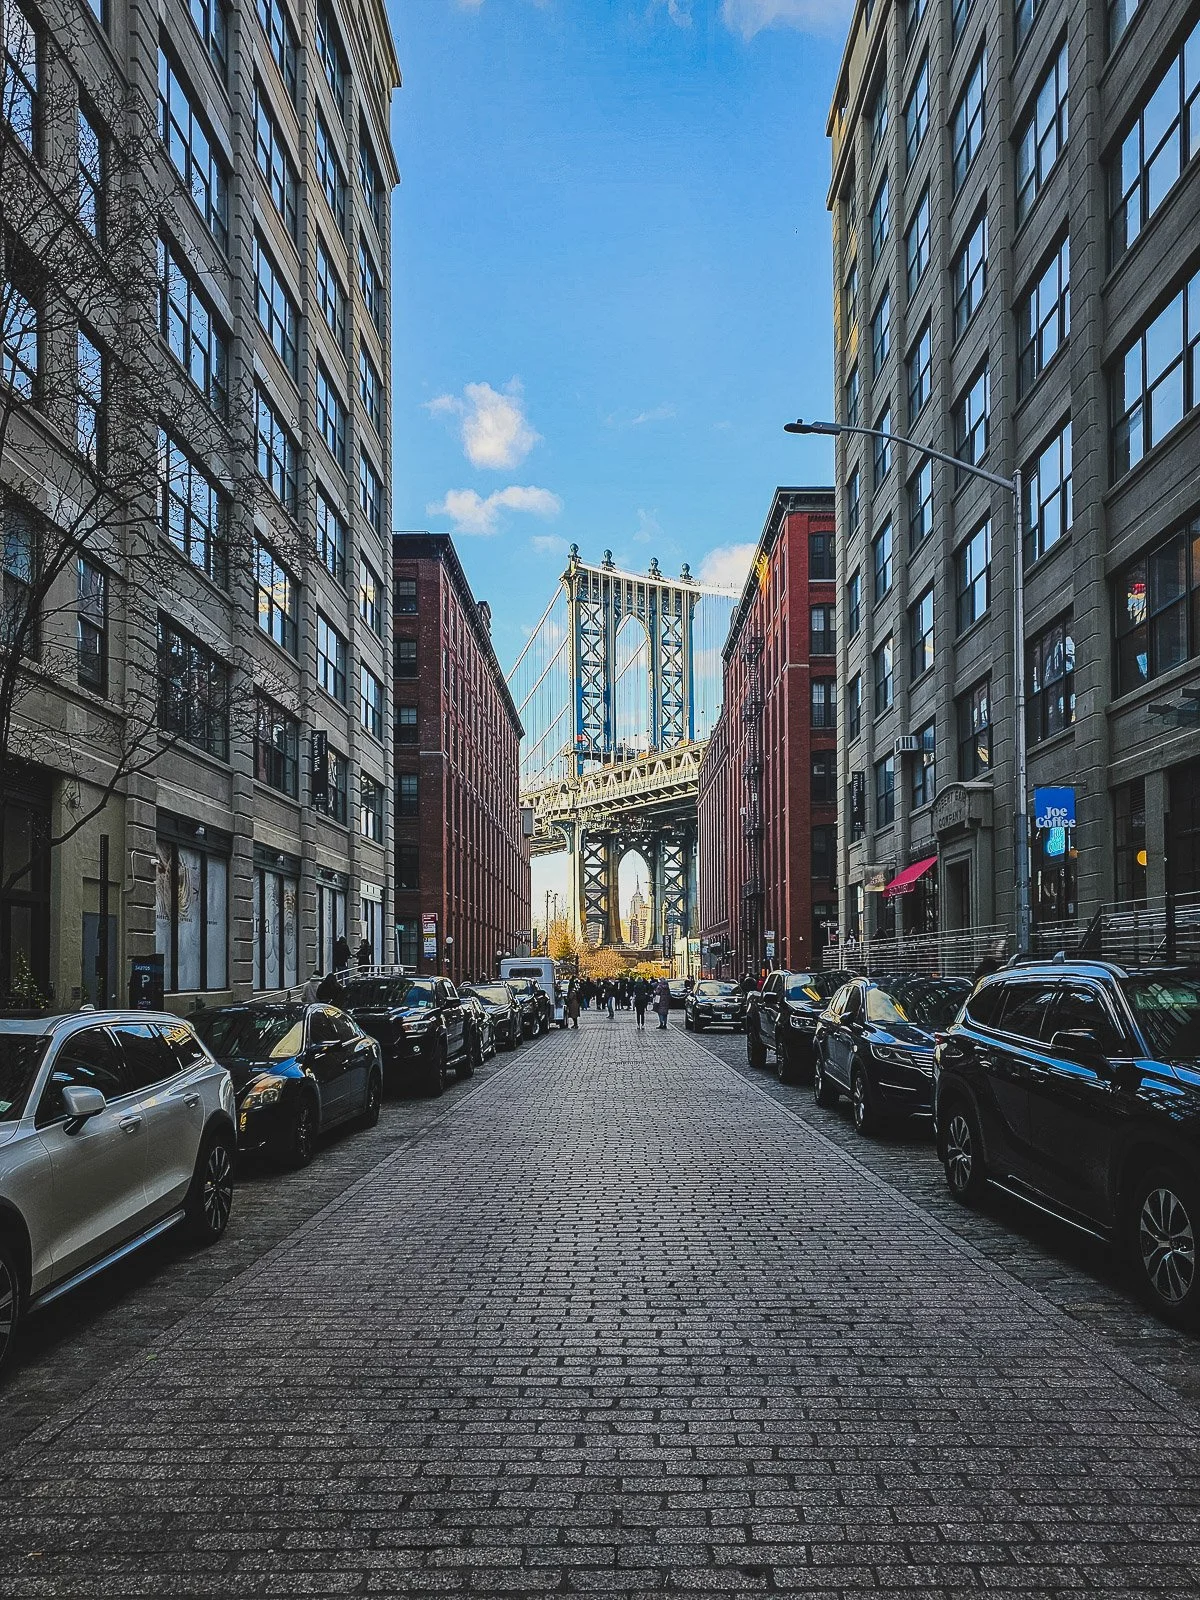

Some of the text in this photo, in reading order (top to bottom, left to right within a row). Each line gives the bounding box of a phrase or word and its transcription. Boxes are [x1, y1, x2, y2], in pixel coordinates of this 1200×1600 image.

[1044, 806, 1068, 820] Joe
[1036, 817, 1076, 828] Coffee
[141, 974, 151, 988] P
